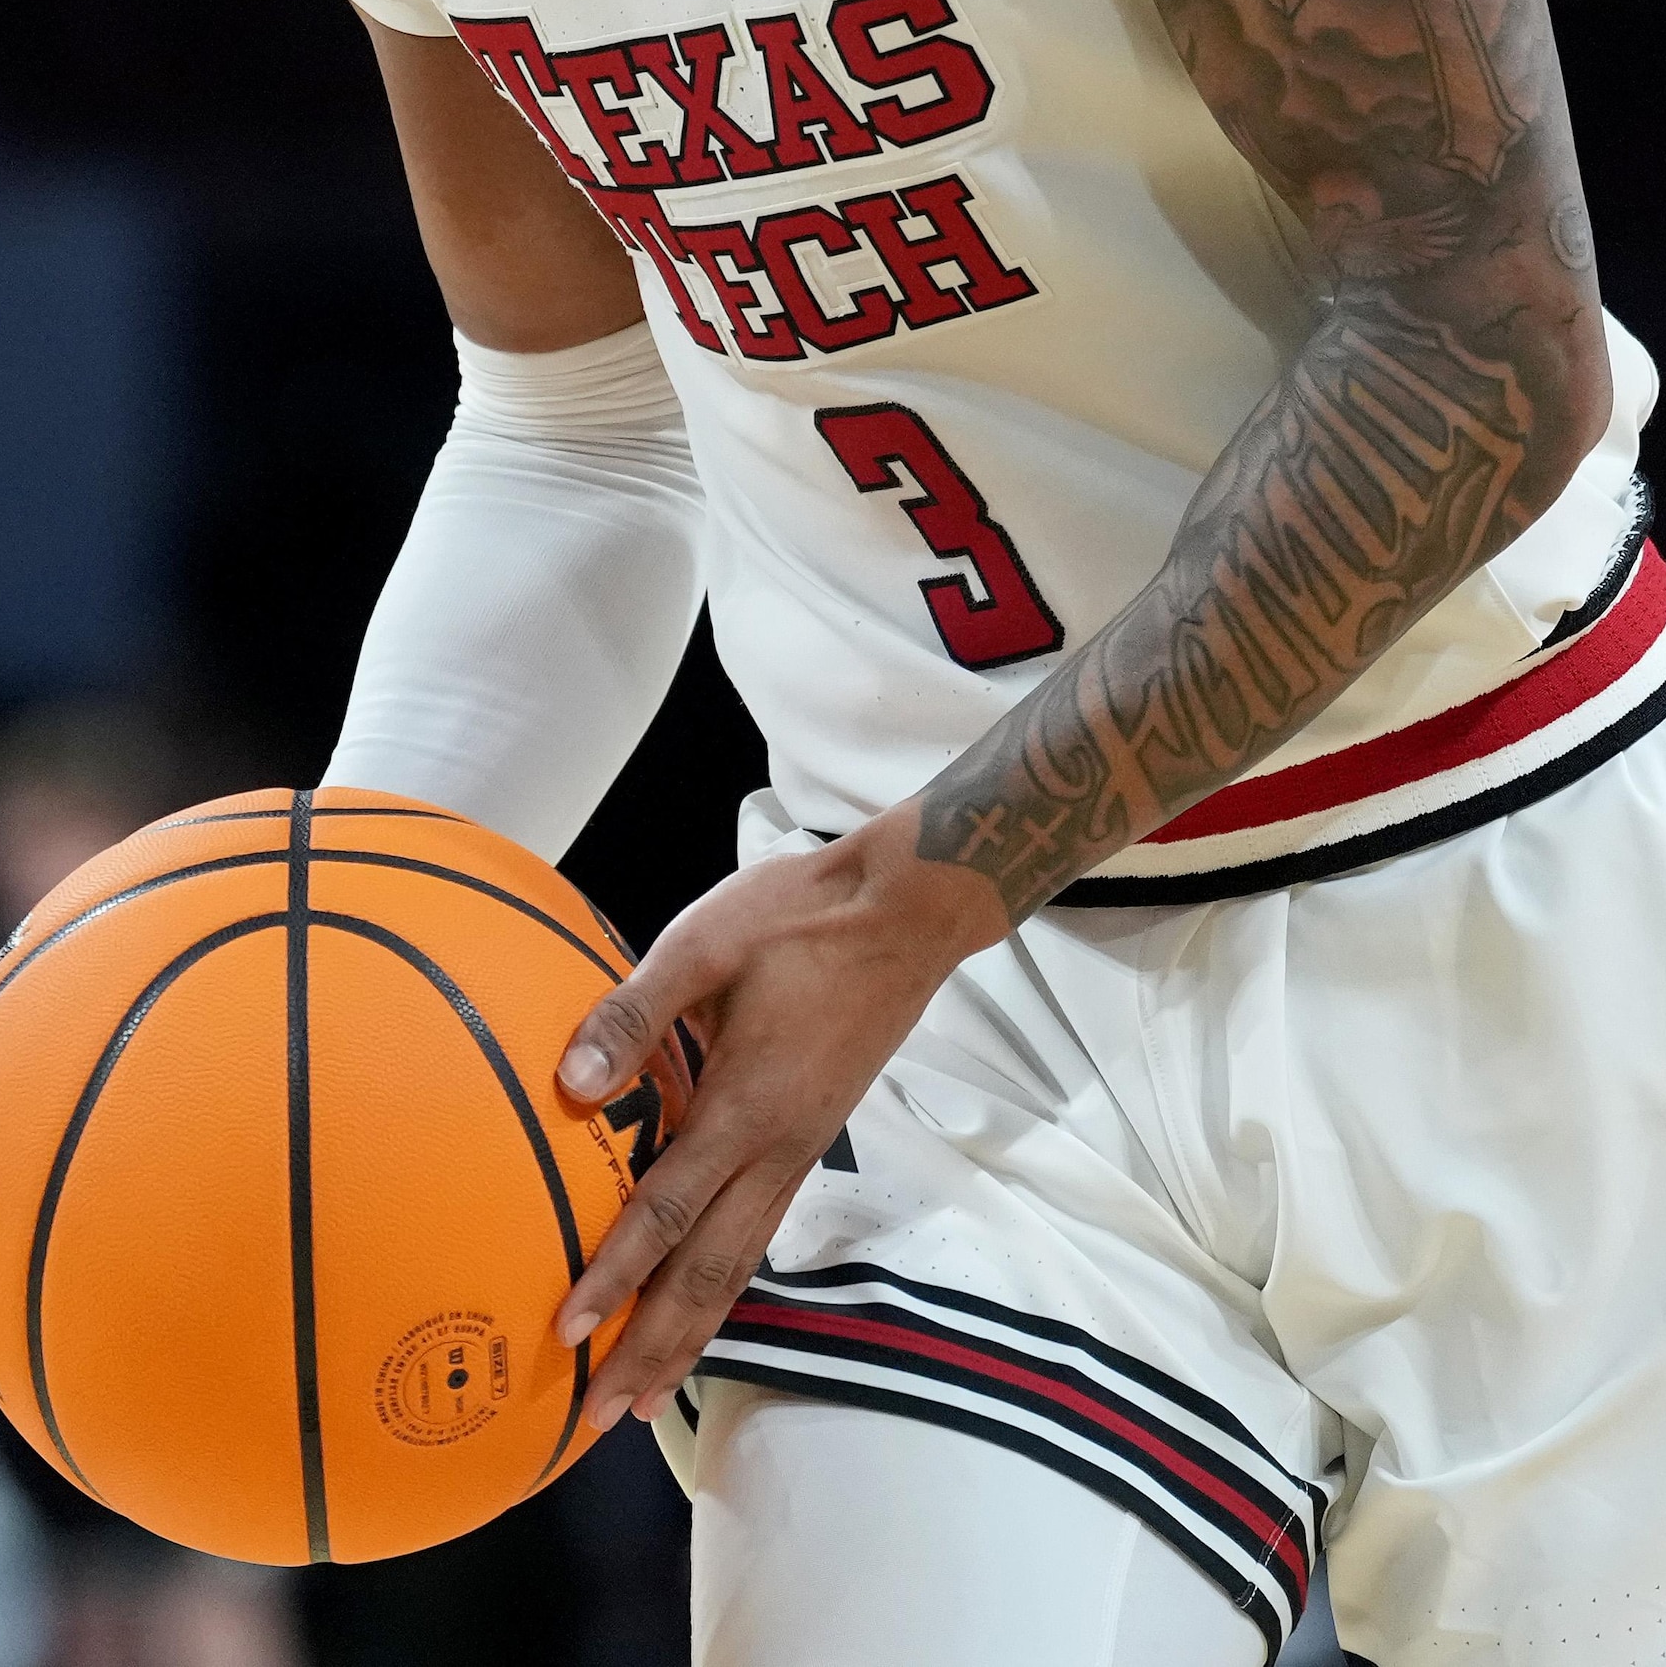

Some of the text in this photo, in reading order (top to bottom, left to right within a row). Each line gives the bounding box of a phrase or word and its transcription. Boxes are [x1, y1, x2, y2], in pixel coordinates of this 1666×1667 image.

[581, 173, 1039, 362] TECH
[814, 402, 1066, 670] 3
[587, 1118, 630, 1206] OFFIC
